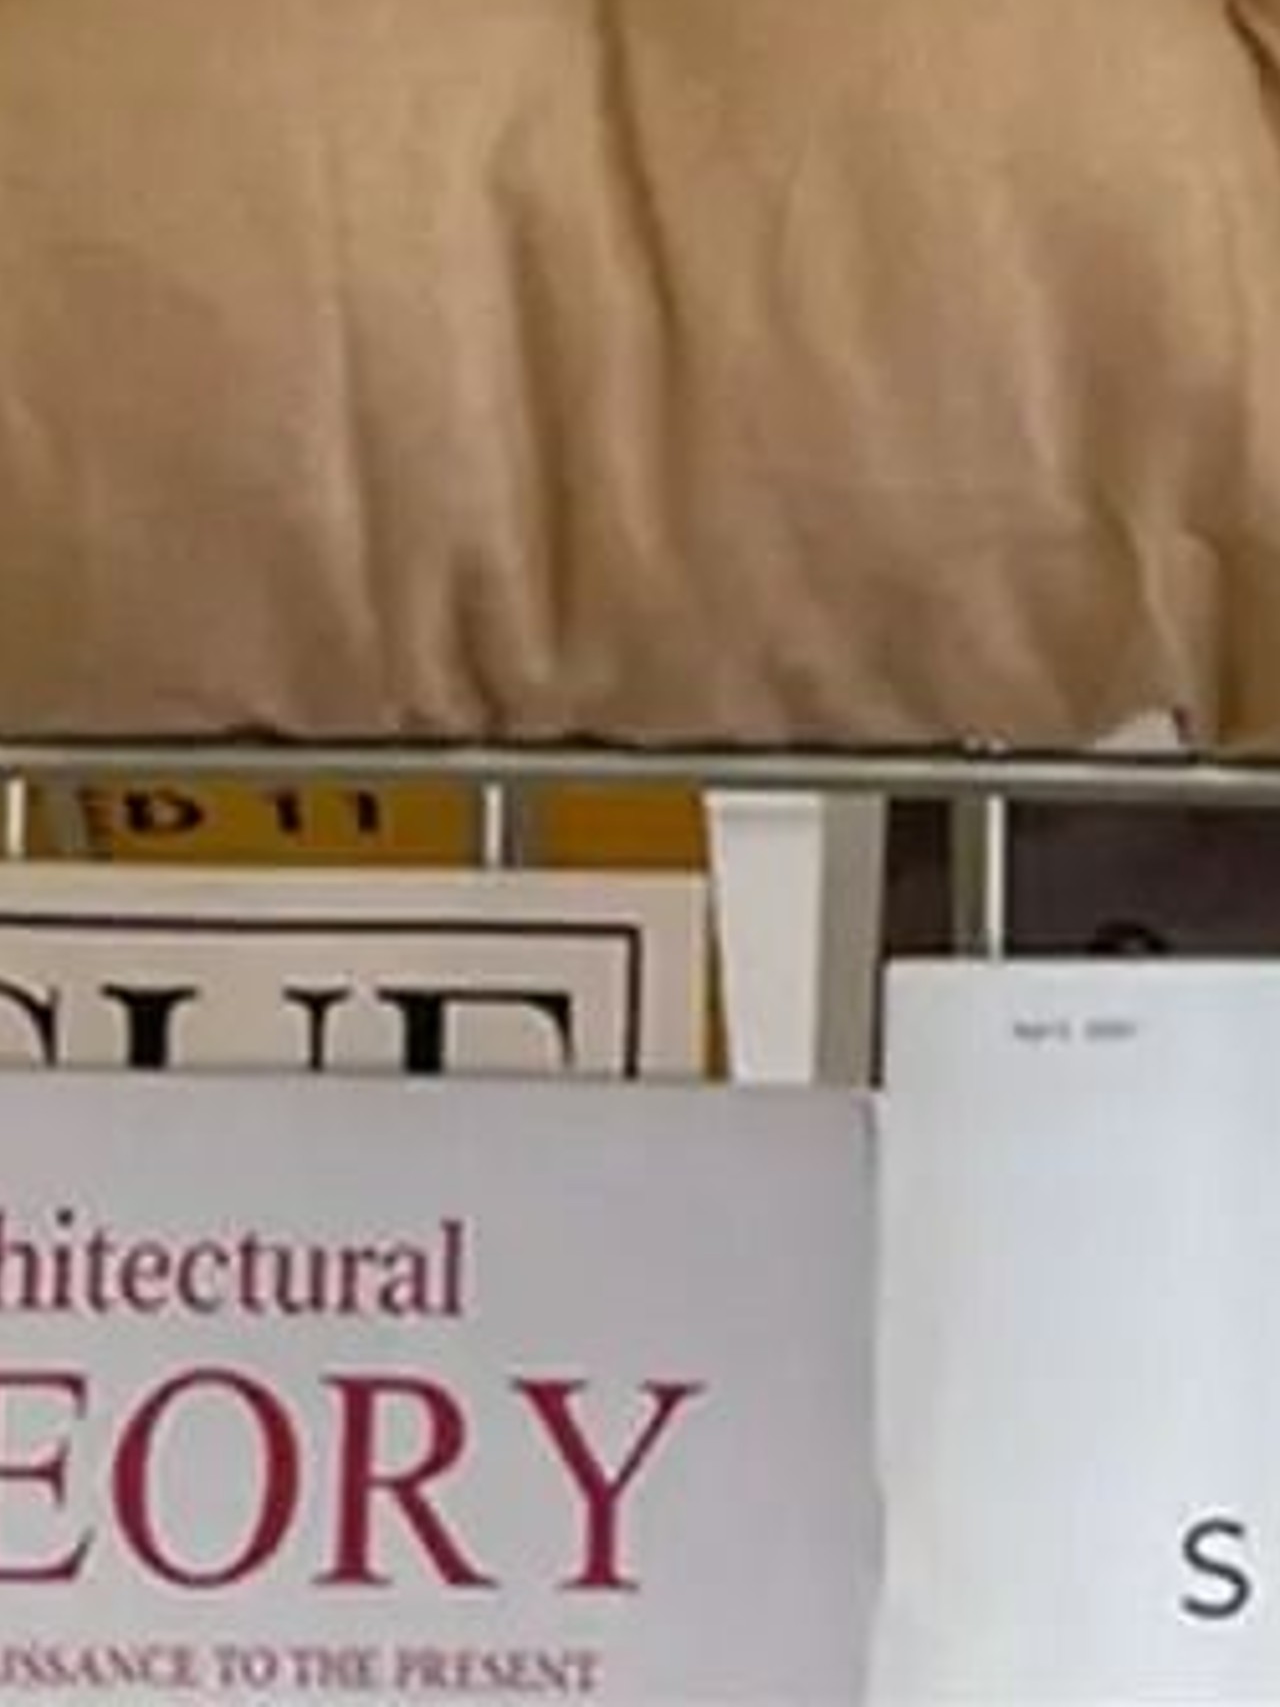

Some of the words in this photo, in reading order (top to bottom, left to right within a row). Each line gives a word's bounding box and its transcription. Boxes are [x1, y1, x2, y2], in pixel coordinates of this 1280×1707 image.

[214, 1645, 280, 1690] TO
[290, 1646, 377, 1691] THE
[393, 1647, 600, 1694] PRESENT
